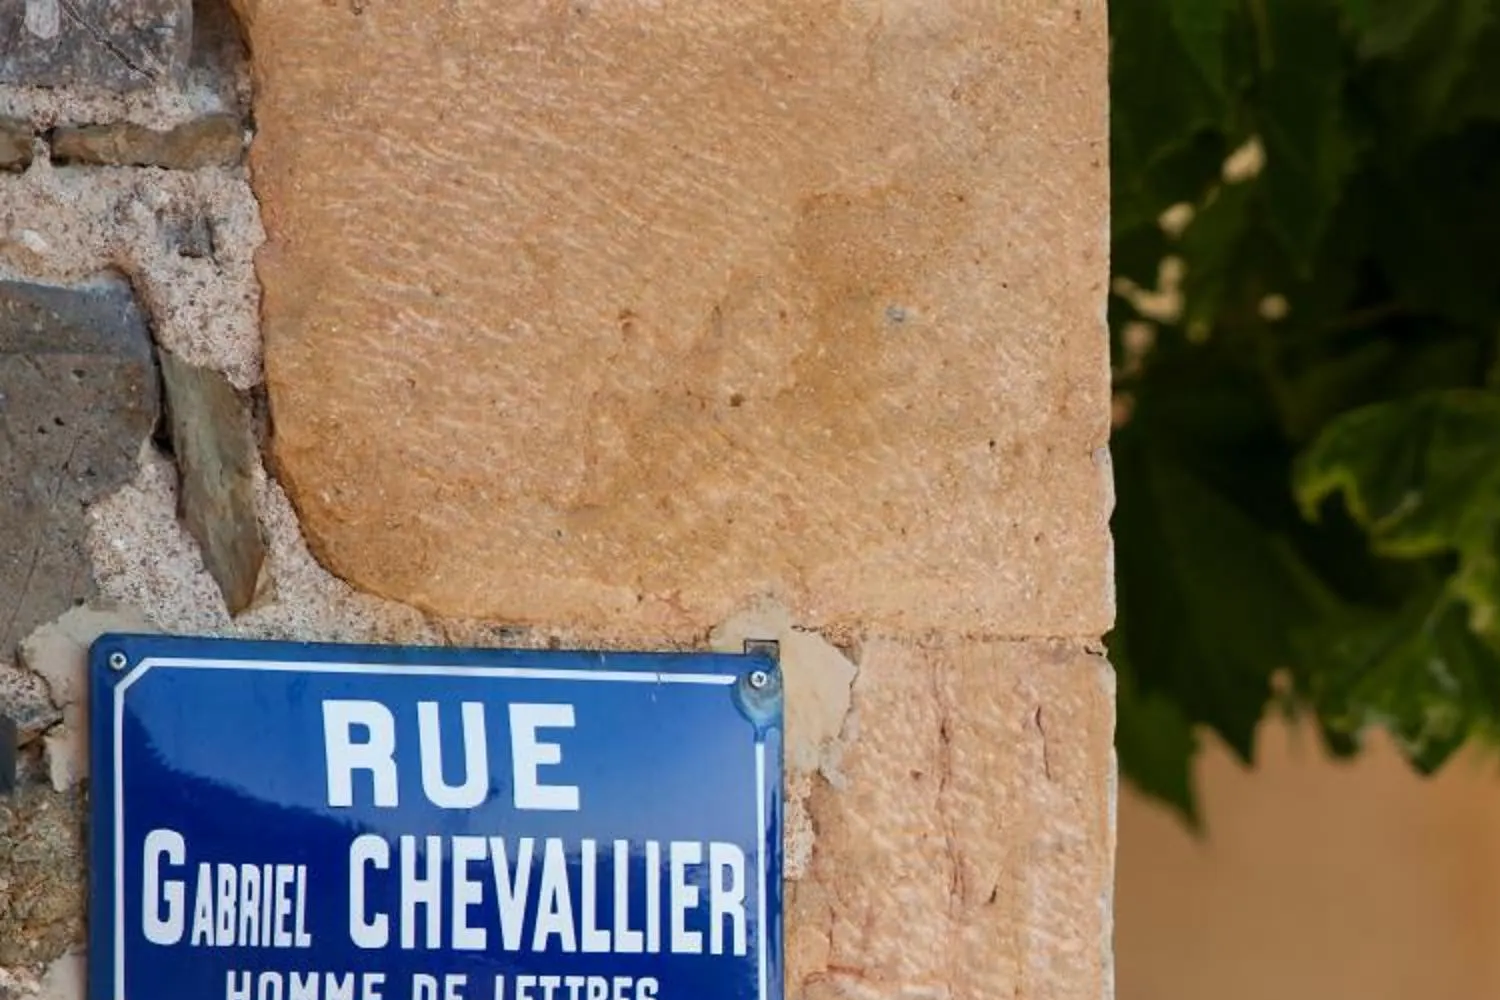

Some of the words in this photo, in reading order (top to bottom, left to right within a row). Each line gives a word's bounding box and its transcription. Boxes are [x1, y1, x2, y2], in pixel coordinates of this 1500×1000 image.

[322, 699, 581, 811] RUE
[142, 829, 312, 947] GABRIEL
[349, 834, 747, 956] CHEVALLIER
